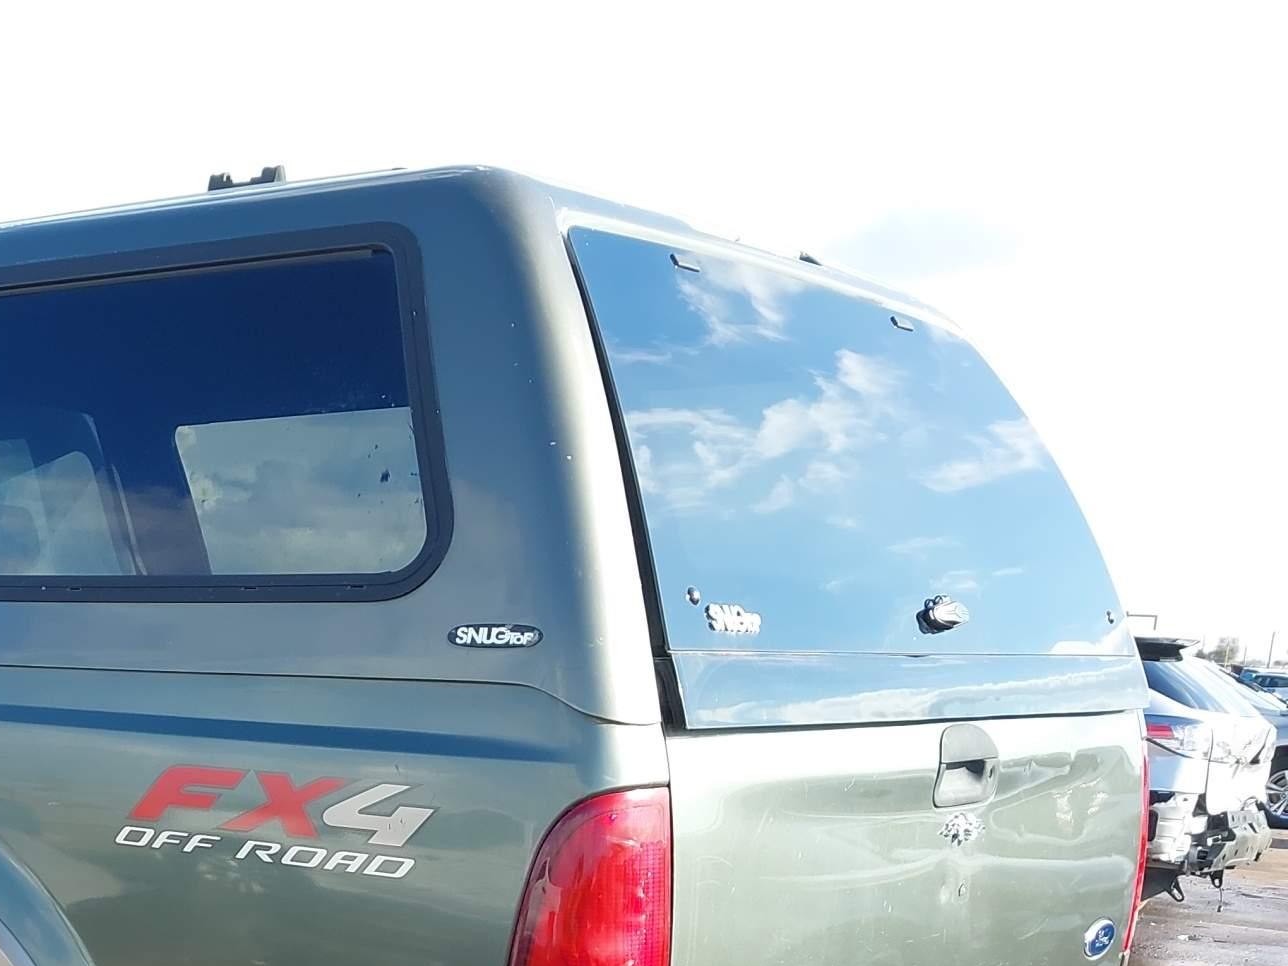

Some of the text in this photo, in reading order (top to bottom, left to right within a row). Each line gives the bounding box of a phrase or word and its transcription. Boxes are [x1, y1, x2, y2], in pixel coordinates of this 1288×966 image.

[128, 764, 440, 847] FX4
[114, 825, 416, 879] OFF ROAD
